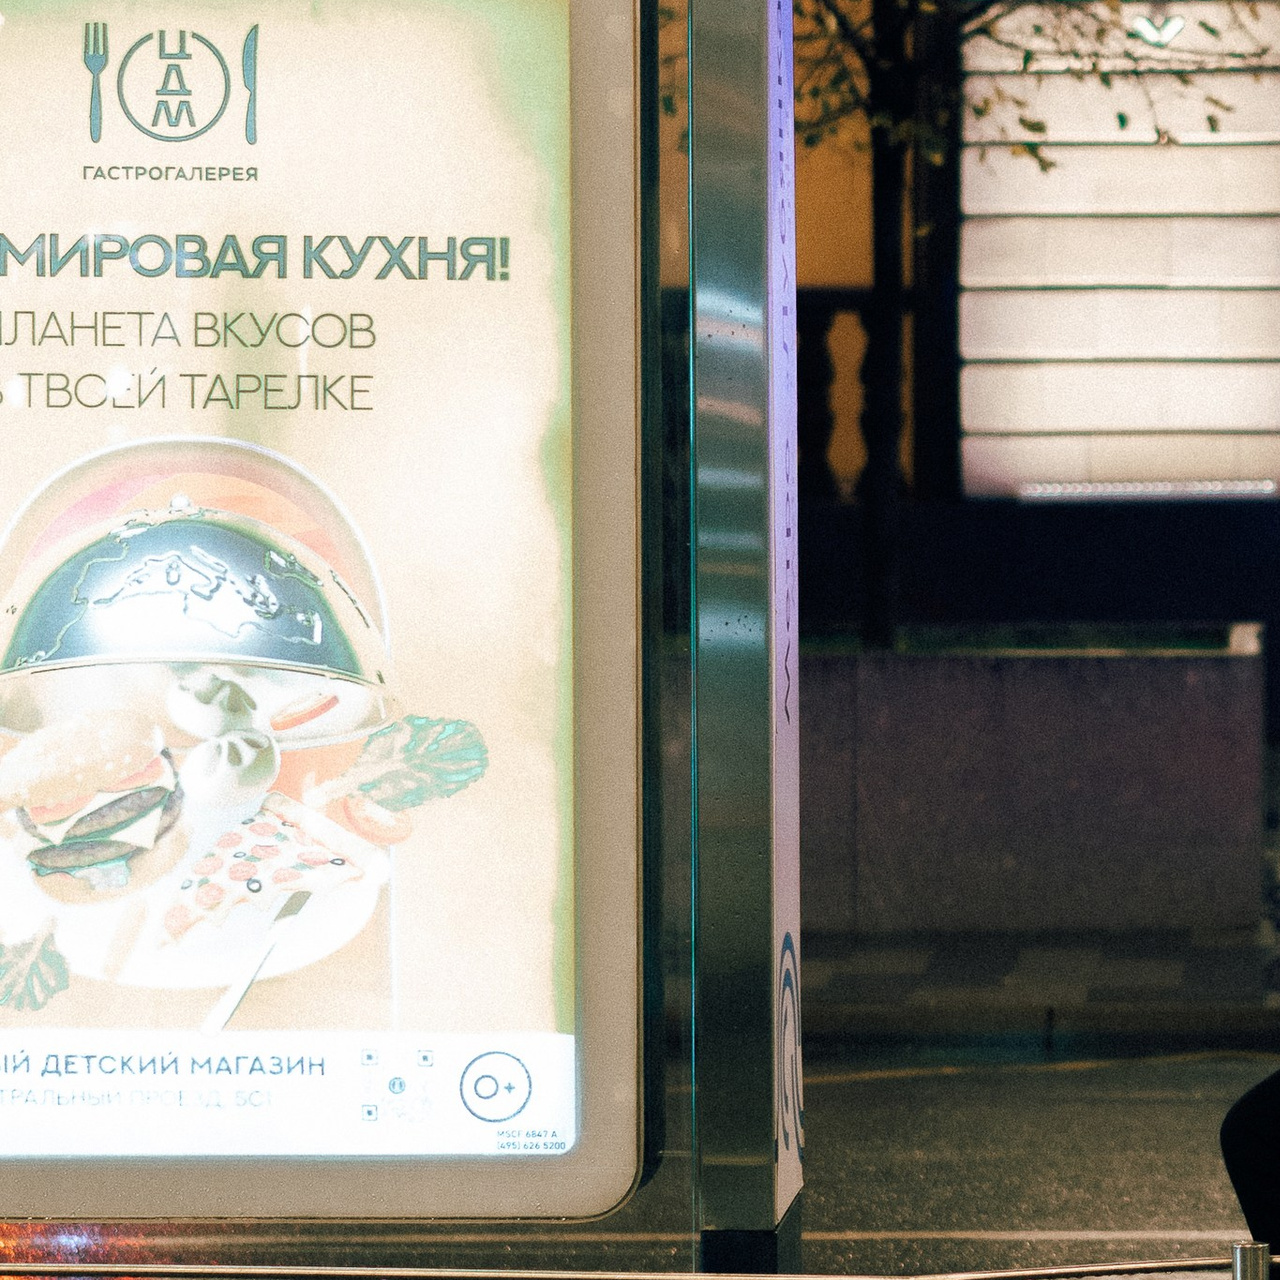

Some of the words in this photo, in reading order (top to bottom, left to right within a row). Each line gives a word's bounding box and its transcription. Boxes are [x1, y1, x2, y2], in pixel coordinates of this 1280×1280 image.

[151, 29, 197, 128] ЦДМ
[82, 165, 259, 182] ГАСТРОГАЛЕРЕЯ
[0, 233, 288, 279] МИРОВАЯ
[303, 235, 510, 281] КУХНЯ!
[194, 312, 377, 349] ВКУСОВ
[179, 373, 374, 410] ТАРЕЛКЕ
[41, 1051, 179, 1077] ДЕТСКИЙ
[190, 1056, 326, 1076] МАГАЗИН
[474, 1075, 515, 1099] 0+
[497, 1141, 520, 1150] (495)
[523, 1142, 540, 1150] 626
[543, 1141, 566, 1150] 5200
[525, 1130, 548, 1138] 6847
[551, 1130, 558, 1138] A
